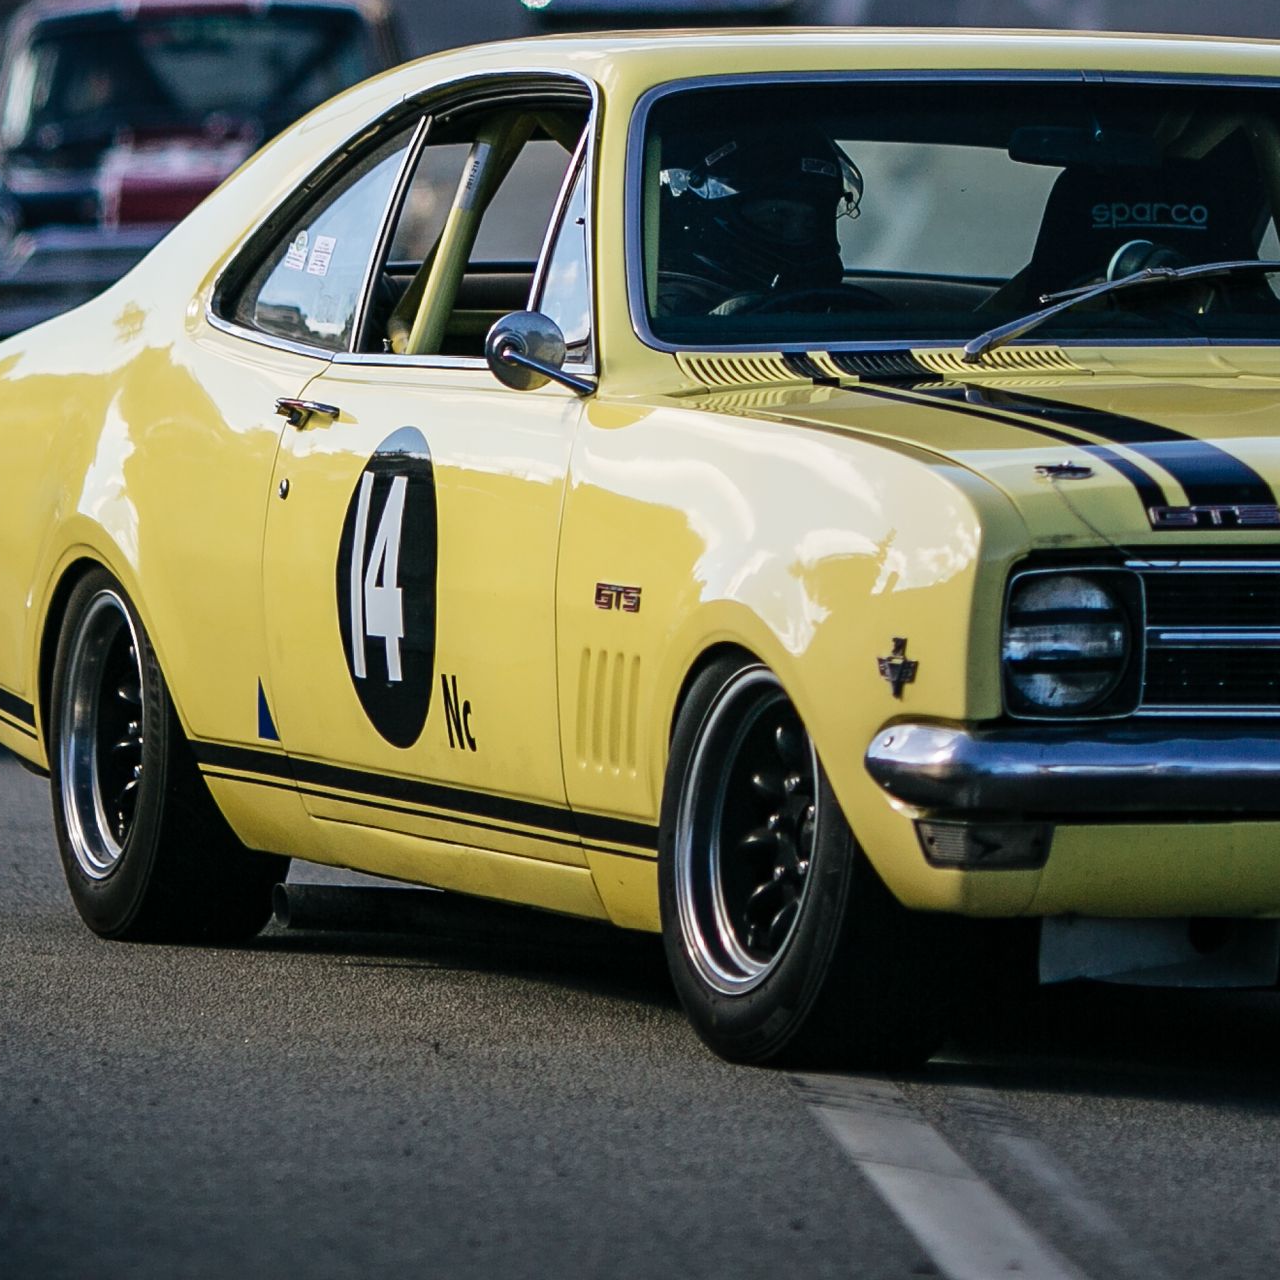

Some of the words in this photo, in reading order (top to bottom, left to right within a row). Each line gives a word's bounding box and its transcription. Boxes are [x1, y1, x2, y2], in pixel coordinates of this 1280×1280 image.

[1091, 203, 1208, 229] sparco
[350, 471, 409, 681] 14
[594, 582, 642, 613] GTS
[440, 673, 477, 752] Nc
